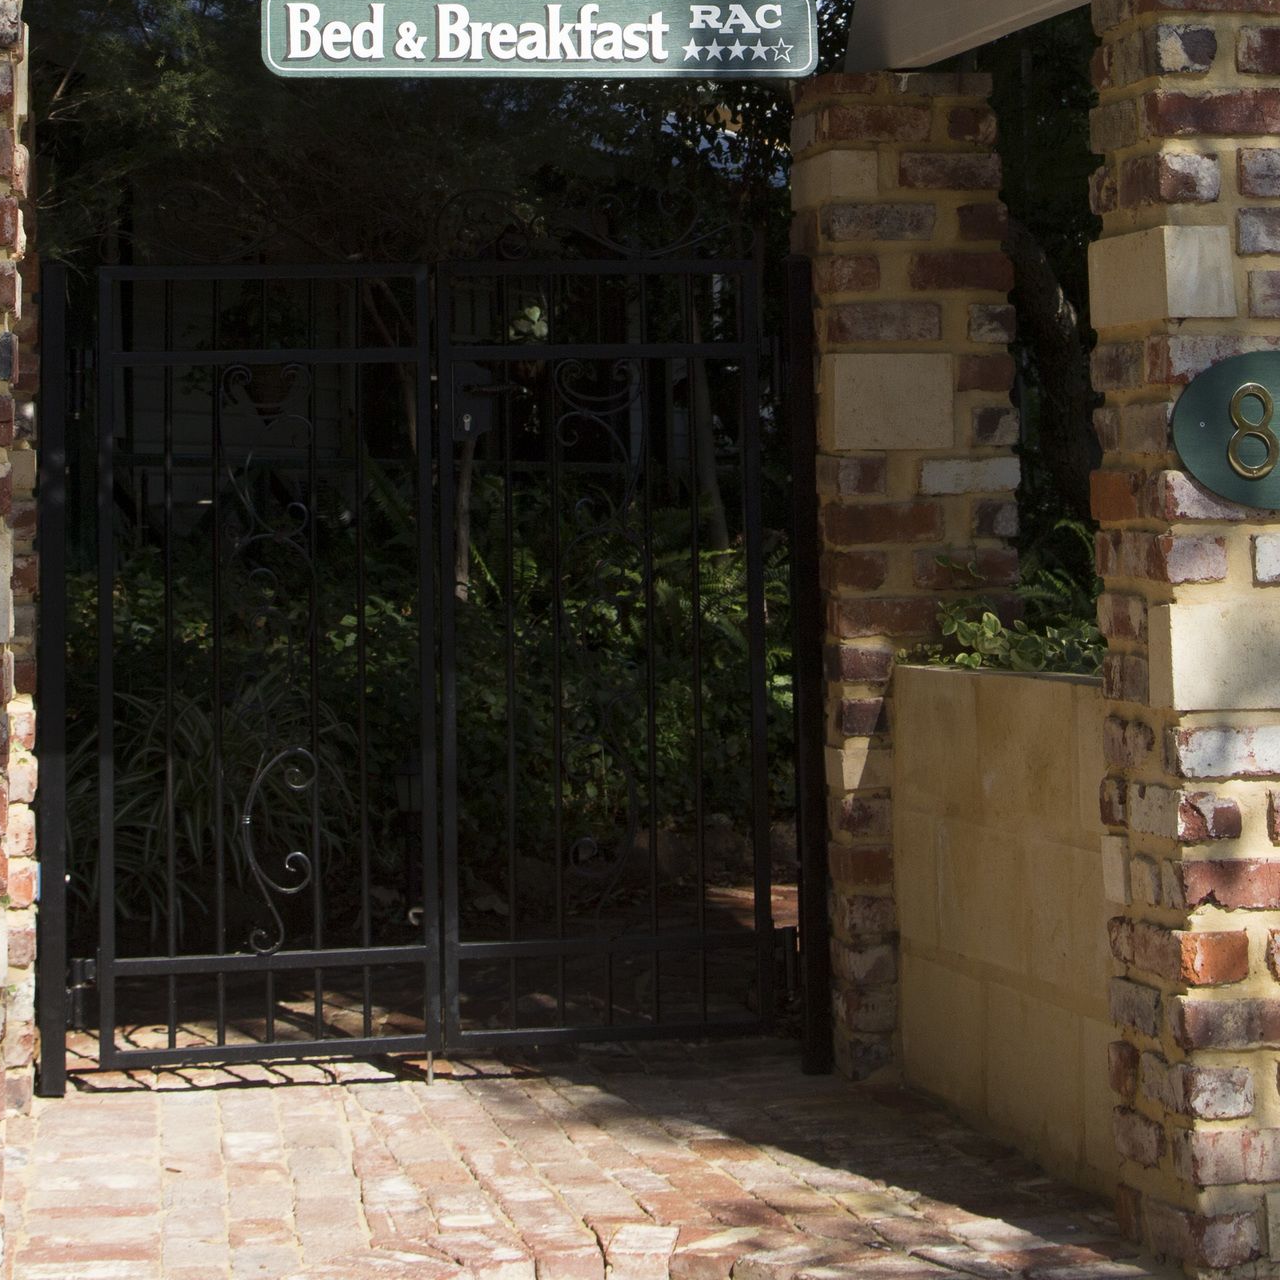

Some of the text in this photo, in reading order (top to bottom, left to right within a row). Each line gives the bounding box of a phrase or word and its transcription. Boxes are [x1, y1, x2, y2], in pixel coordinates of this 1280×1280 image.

[285, 2, 669, 60] Bed & Breakfast
[688, 3, 782, 34] RAC
